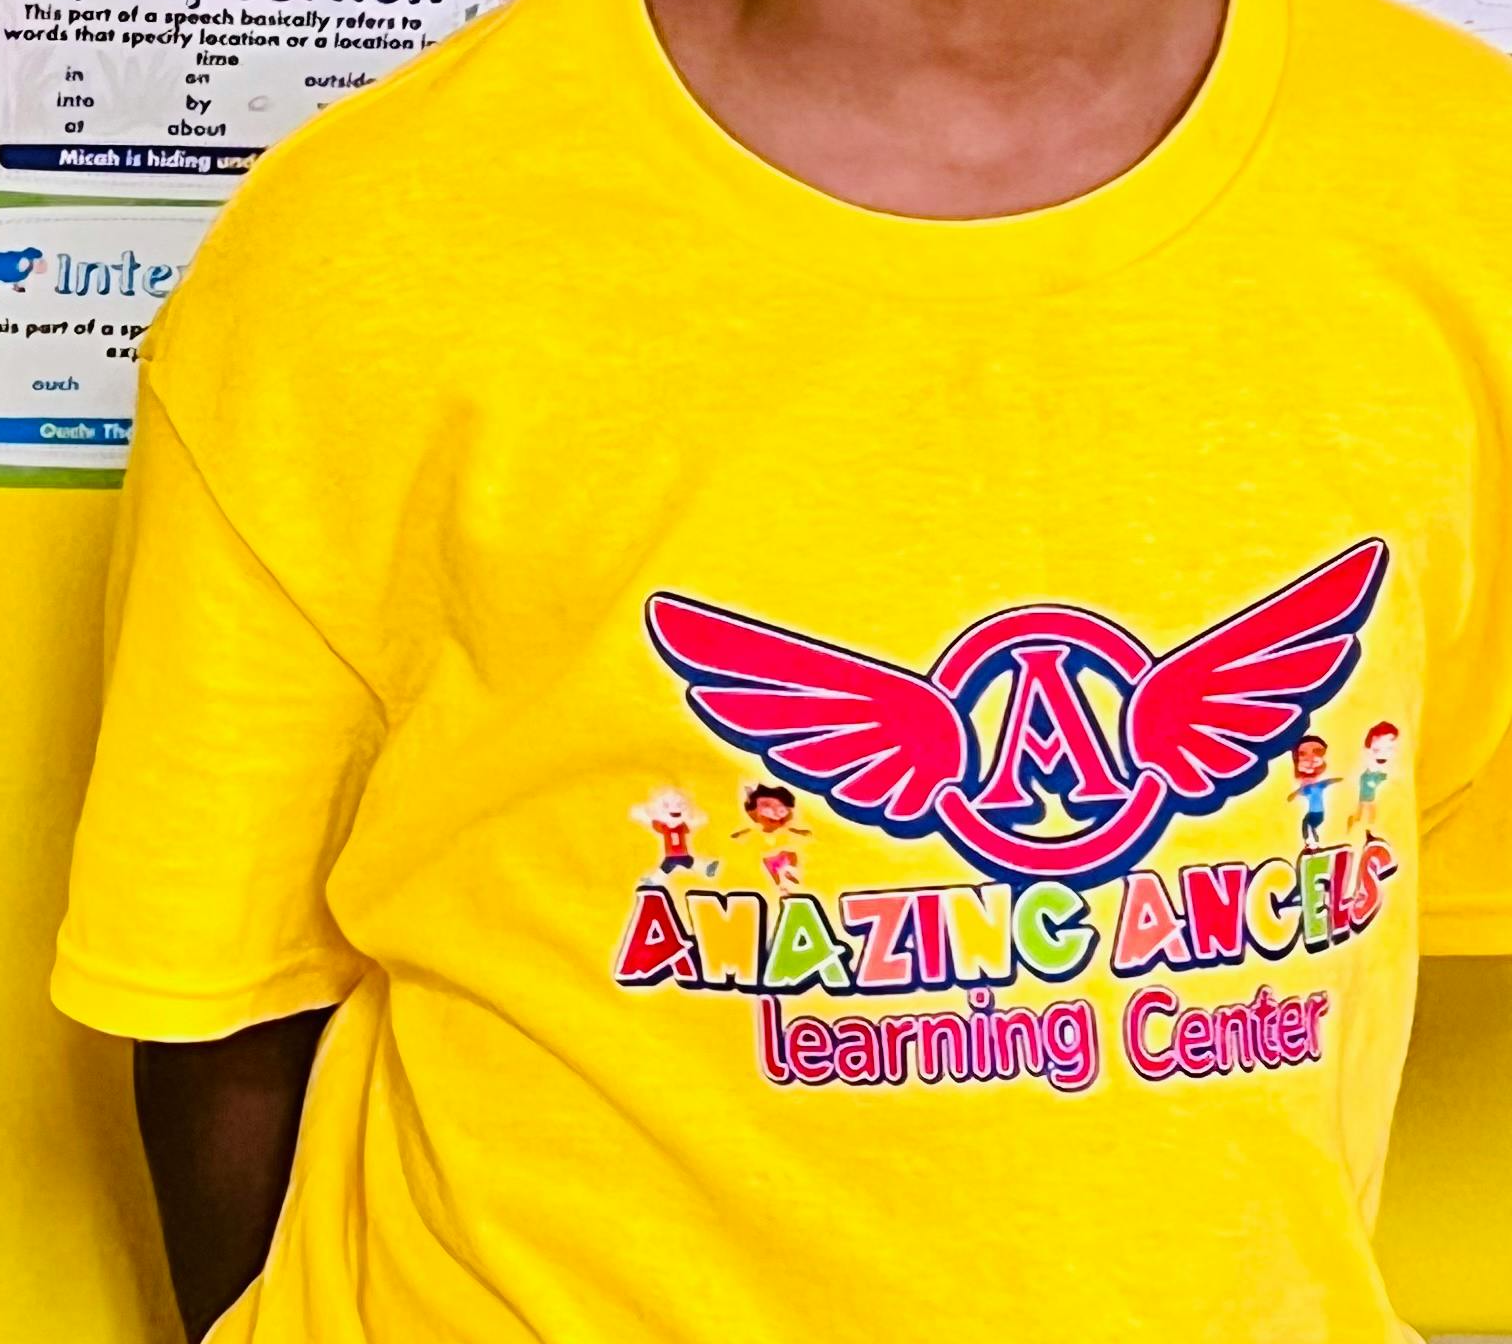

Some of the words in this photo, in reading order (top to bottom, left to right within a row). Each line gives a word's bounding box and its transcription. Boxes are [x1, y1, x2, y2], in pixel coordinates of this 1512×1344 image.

[25, 4, 61, 20] This
[69, 9, 111, 25] part
[118, 5, 138, 23] of
[145, 11, 157, 23] a
[165, 9, 233, 29] speech
[241, 9, 330, 32] basically
[337, 12, 395, 29] refers
[402, 17, 422, 30] to
[4, 24, 68, 41] words
[75, 26, 115, 42] that
[122, 27, 193, 48] specify
[199, 28, 279, 46] location
[286, 36, 309, 47] or
[315, 36, 327, 48] a
[334, 33, 414, 49] location
[65, 66, 84, 81] in
[57, 92, 94, 107] into
[186, 94, 211, 115] by
[168, 119, 226, 136] about
[59, 149, 120, 166] Micah
[126, 150, 141, 166] is
[147, 150, 211, 173] hiding
[25, 322, 68, 338] part
[74, 319, 95, 335] of
[102, 324, 113, 336] a
[615, 879, 1095, 995] AMAZING
[1112, 836, 1397, 977] ANGELS
[759, 984, 1098, 1091] learning
[1129, 984, 1329, 1086] Center
